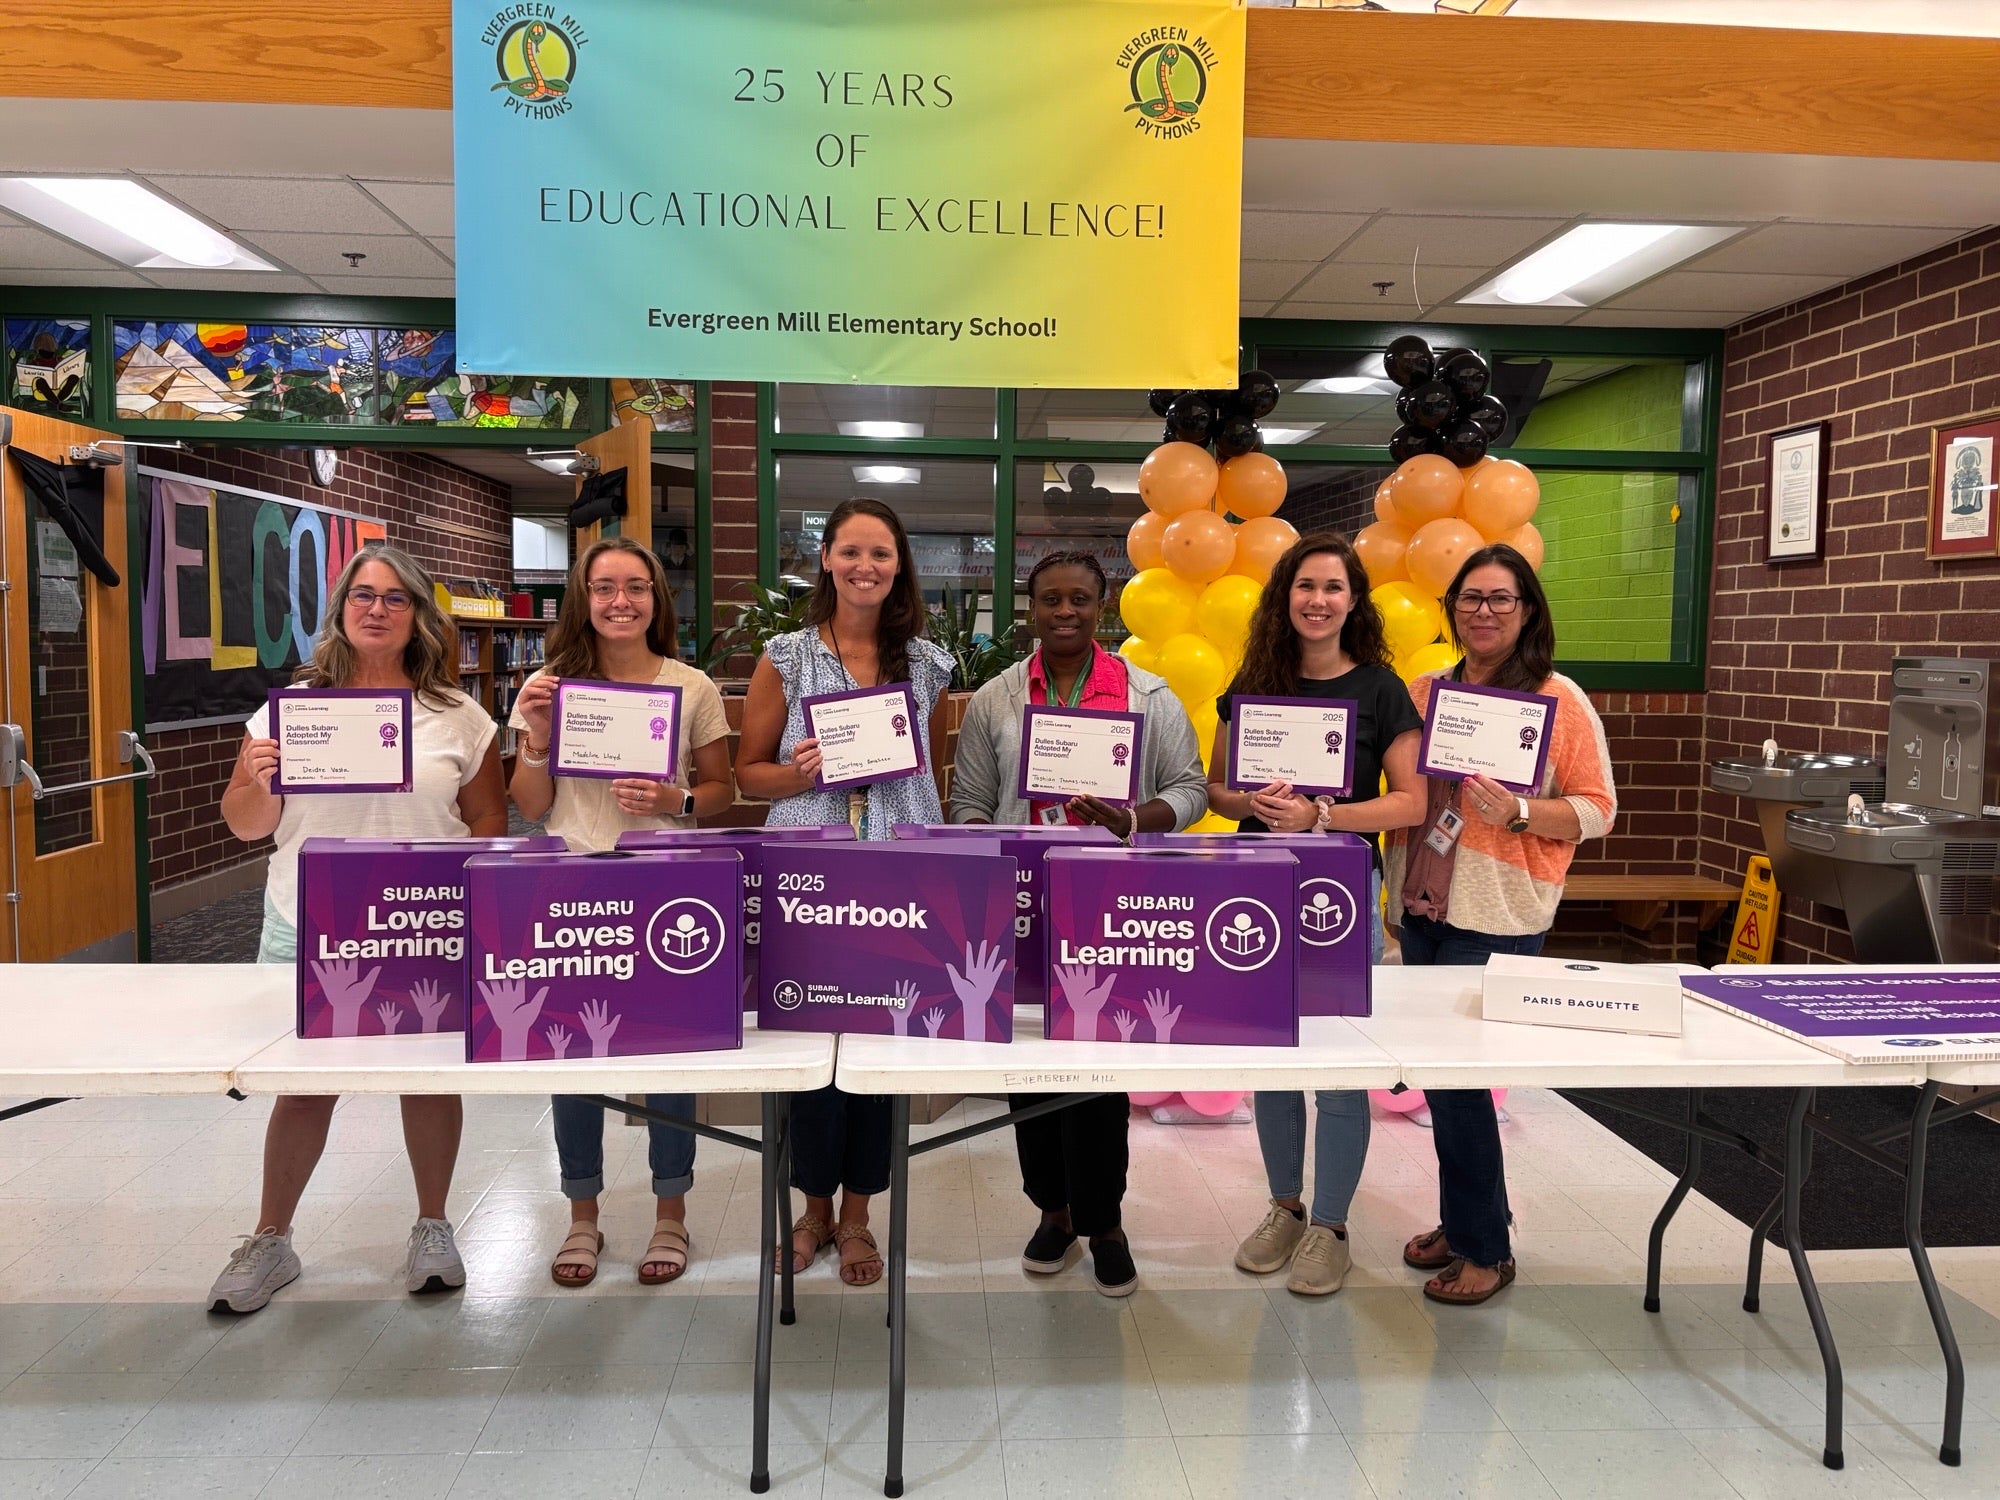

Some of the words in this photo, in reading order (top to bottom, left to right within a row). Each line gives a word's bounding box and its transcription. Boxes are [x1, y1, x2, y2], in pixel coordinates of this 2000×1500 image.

[481, 2, 556, 46] EVERGREEN
[560, 14, 589, 50] MILL
[1116, 26, 1188, 69] EVERGREEN
[1192, 36, 1219, 71] MILL
[733, 67, 785, 103] 25
[816, 70, 953, 108] YEARS
[503, 96, 573, 120] PYTHONS
[1135, 116, 1201, 140] PYTHONS
[815, 133, 870, 168] OF
[540, 187, 847, 230] EDUCATIONAL
[876, 197, 1164, 238] EXCELLENCE!
[647, 308, 770, 335] Evergreen
[777, 312, 820, 333] Mill
[828, 313, 963, 341] Elementary
[969, 317, 1057, 338] School!
[375, 704, 398, 713] 2025
[648, 699, 669, 708] 2025
[885, 697, 903, 707] 2025
[567, 712, 588, 720] Dulles
[1322, 713, 1344, 722] 2025
[1439, 713, 1459, 722] Dulles
[1460, 716, 1484, 726] Subaru
[1520, 707, 1542, 718] 2025
[566, 719, 595, 727] Adopted
[596, 721, 607, 729] My
[819, 727, 838, 735] Dulles
[839, 723, 860, 731] Subaru
[1110, 725, 1131, 735] 2025
[1437, 720, 1465, 730] Adopted
[1466, 724, 1476, 732] My
[820, 732, 846, 741] Adopted
[846, 730, 856, 738] My
[1055, 739, 1078, 747] Subaru
[1034, 744, 1061, 752] Adopted
[1062, 746, 1071, 754] My
[777, 873, 825, 892] 2025
[382, 886, 464, 902] SUBARU
[1748, 889, 1768, 901] CAUTION
[549, 900, 634, 918] SUBARU
[1117, 895, 1194, 911] SUBARU
[1754, 900, 1768, 912] FLOOR
[367, 905, 464, 931] Loves
[777, 896, 928, 929] Yearbook
[1103, 912, 1194, 940] Loves
[534, 922, 634, 949] Loves
[318, 932, 464, 961] Learning
[1060, 940, 1196, 973] Learning
[1736, 949, 1757, 963] CUIDADO
[485, 950, 635, 981] Learning
[807, 984, 839, 992] SUBARU
[1863, 977, 1943, 985] Loves
[807, 991, 844, 1004] Loves
[847, 992, 907, 1009] Learning
[1523, 996, 1561, 1006] PARIS
[1568, 998, 1640, 1011] BAGUETTE
